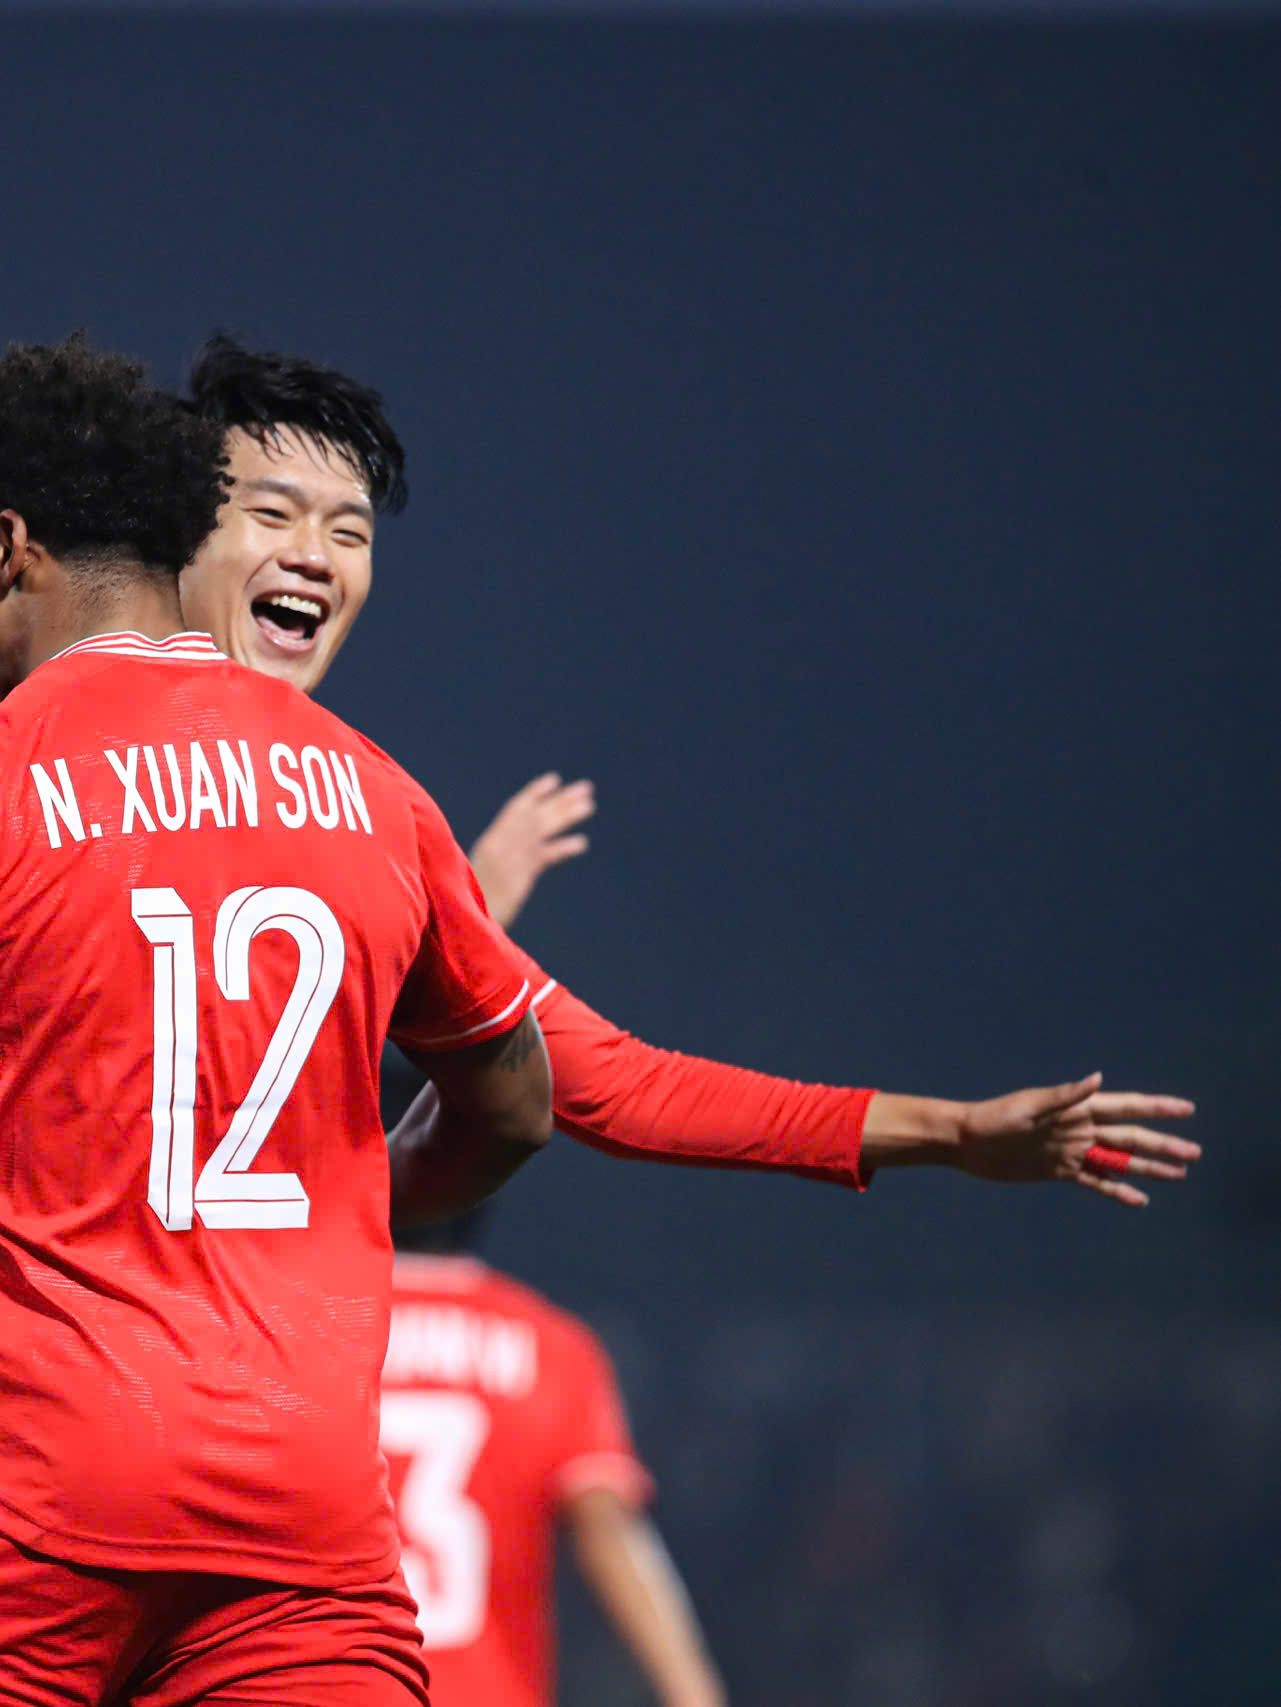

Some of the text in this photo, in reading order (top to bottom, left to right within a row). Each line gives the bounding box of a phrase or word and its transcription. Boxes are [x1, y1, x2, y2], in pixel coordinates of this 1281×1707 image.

[29, 739, 374, 849] N. XUAN SON
[131, 885, 346, 1231] 12
